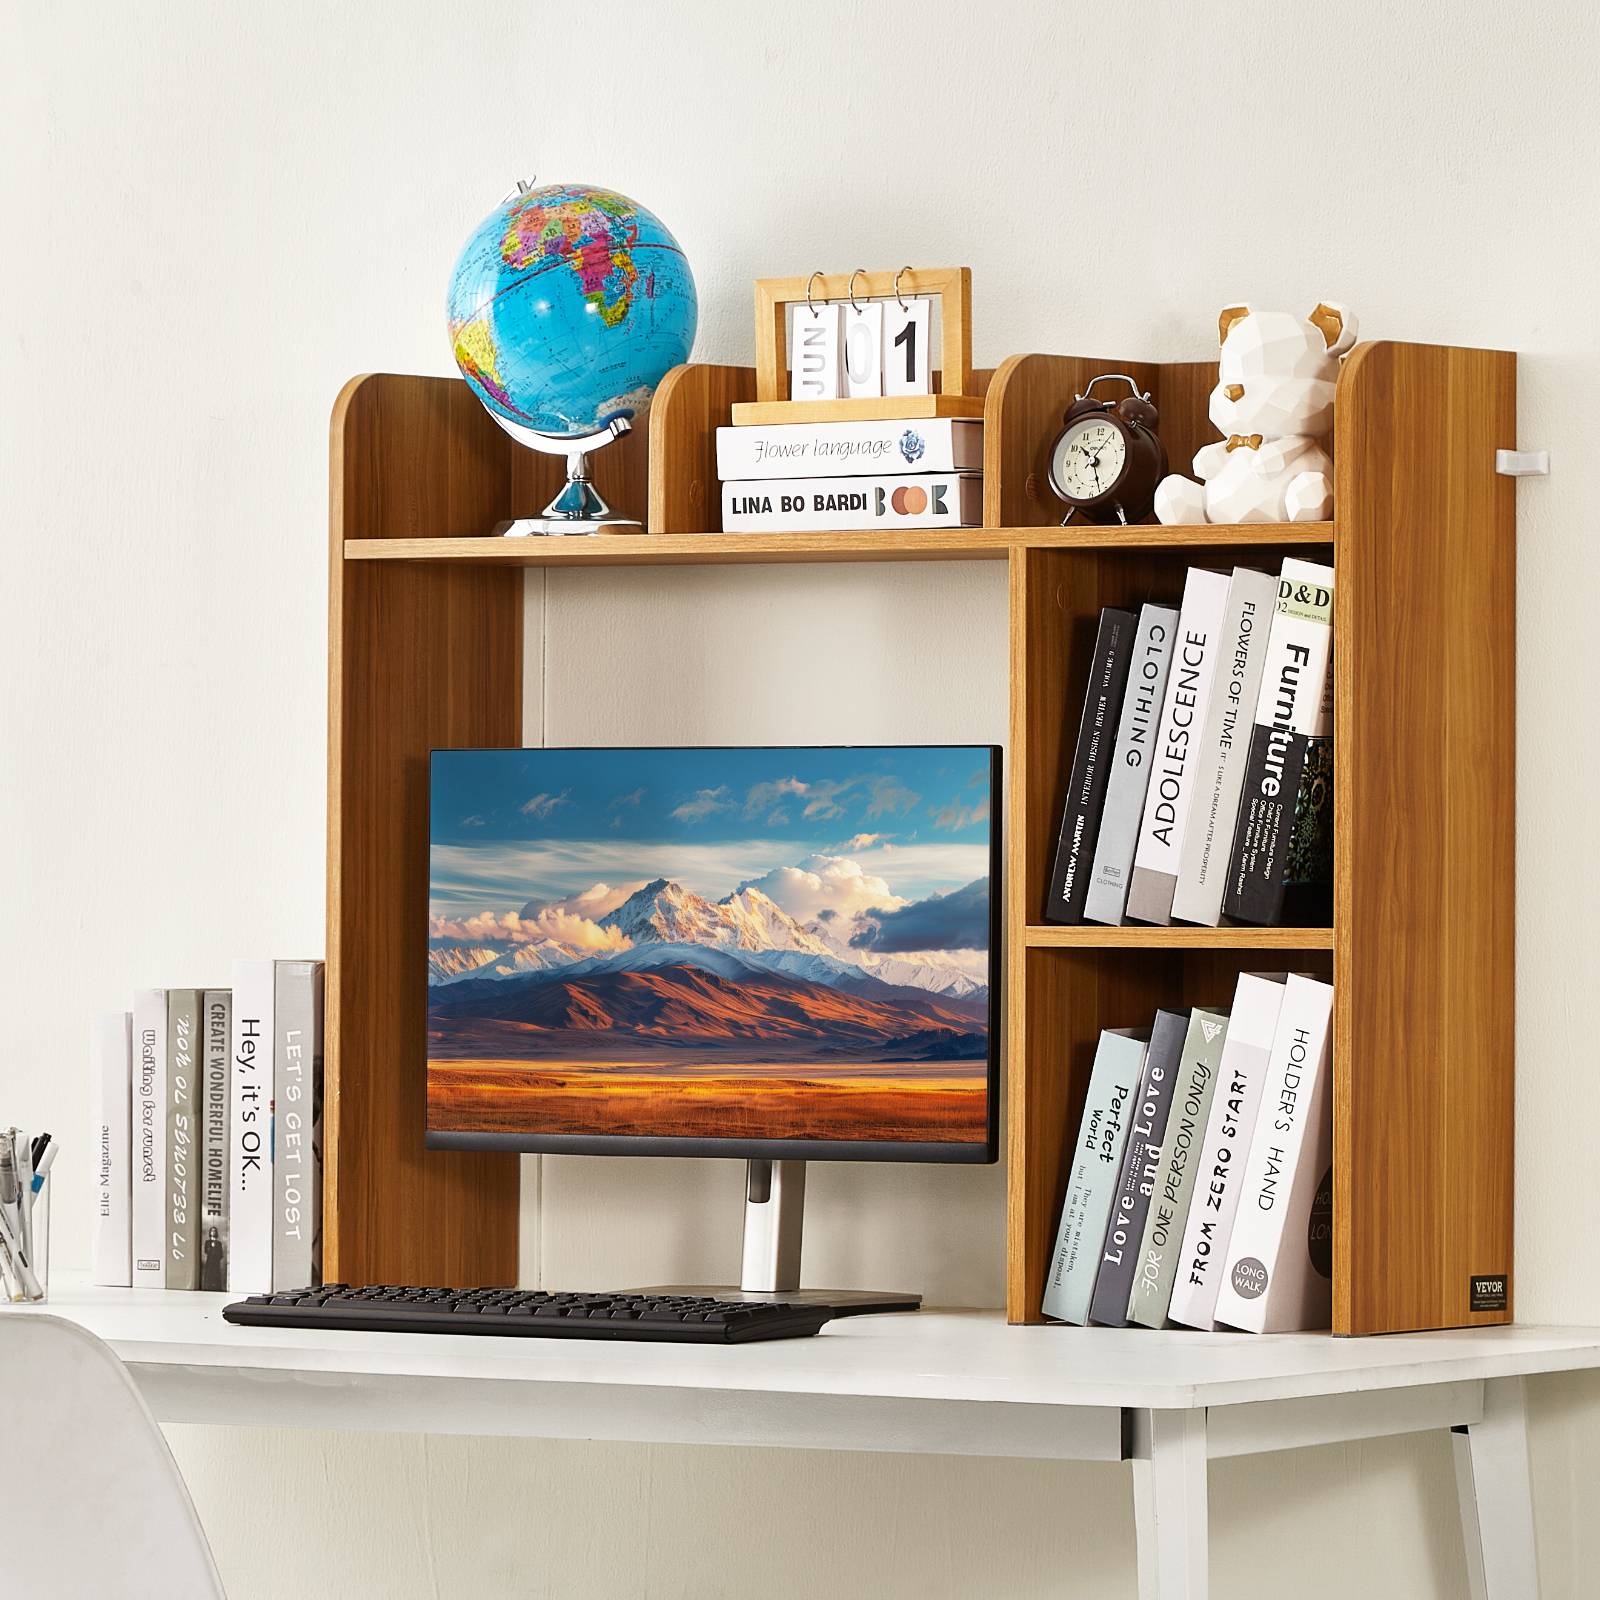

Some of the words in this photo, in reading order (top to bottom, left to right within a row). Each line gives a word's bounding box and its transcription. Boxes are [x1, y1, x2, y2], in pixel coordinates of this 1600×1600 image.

[803, 327, 827, 395] JUN
[894, 321, 916, 382] 1
[753, 439, 809, 463] Flower
[813, 438, 893, 460] language
[1083, 433, 1089, 441] 11
[1097, 428, 1105, 436] 12
[732, 496, 772, 514] LINA
[781, 495, 805, 513] BO
[814, 493, 867, 511] BARDI
[1233, 601, 1255, 678] FLOWERS
[1126, 624, 1166, 768] CLOTHING
[1228, 681, 1241, 705] OF
[1152, 630, 1207, 847] ADOLESCENCE
[1220, 709, 1238, 749] TIME
[1262, 643, 1310, 798] Furniture
[1080, 764, 1095, 805] INTERIOR
[1088, 731, 1100, 762] DESIGN
[1095, 696, 1107, 727] REVIEW
[1210, 791, 1219, 819] DREAM
[1258, 800, 1266, 819] Office
[1062, 855, 1077, 902] ANDREW
[1071, 814, 1085, 855] MARTIN
[1260, 824, 1271, 852] Furniture
[1268, 828, 1279, 856] Furniture
[1263, 857, 1274, 880] Design
[209, 1003, 225, 1053] CREATE
[236, 1019, 260, 1074] Hey,
[140, 1030, 156, 1096] Waiting
[286, 1030, 302, 1101] LET'S
[1274, 1028, 1310, 1132] HOLDER'S
[142, 1100, 156, 1126] for
[174, 1076, 188, 1104] TO
[208, 1057, 225, 1143] WONDERFUL
[241, 1086, 260, 1122] it's
[1133, 1066, 1165, 1138] Love
[284, 1114, 301, 1164] GET
[1086, 1109, 1104, 1150] World
[1100, 1085, 1129, 1163] Perfect
[100, 1125, 111, 1186] Magazine
[142, 1128, 156, 1182] sunset
[172, 1113, 190, 1224] BELONGS
[1078, 1165, 1086, 1180] but
[1139, 1143, 1162, 1197] and
[1189, 1222, 1217, 1286] FROM
[1207, 1148, 1232, 1211] ZERO
[1222, 1069, 1249, 1138] START
[1258, 1146, 1284, 1212] HAND
[100, 1192, 110, 1217] Elle
[207, 1149, 224, 1217] HOMELIFE
[284, 1174, 301, 1240] LOST
[1081, 1188, 1092, 1208] They
[1153, 1206, 1174, 1247] ONE
[1164, 1118, 1196, 1204] PERSON
[1063, 1223, 1072, 1244] your
[1104, 1195, 1135, 1266] Love
[1235, 1276, 1263, 1294] WALK.
[1236, 1264, 1265, 1280] LONG
[1476, 1281, 1503, 1293] VEVOR
